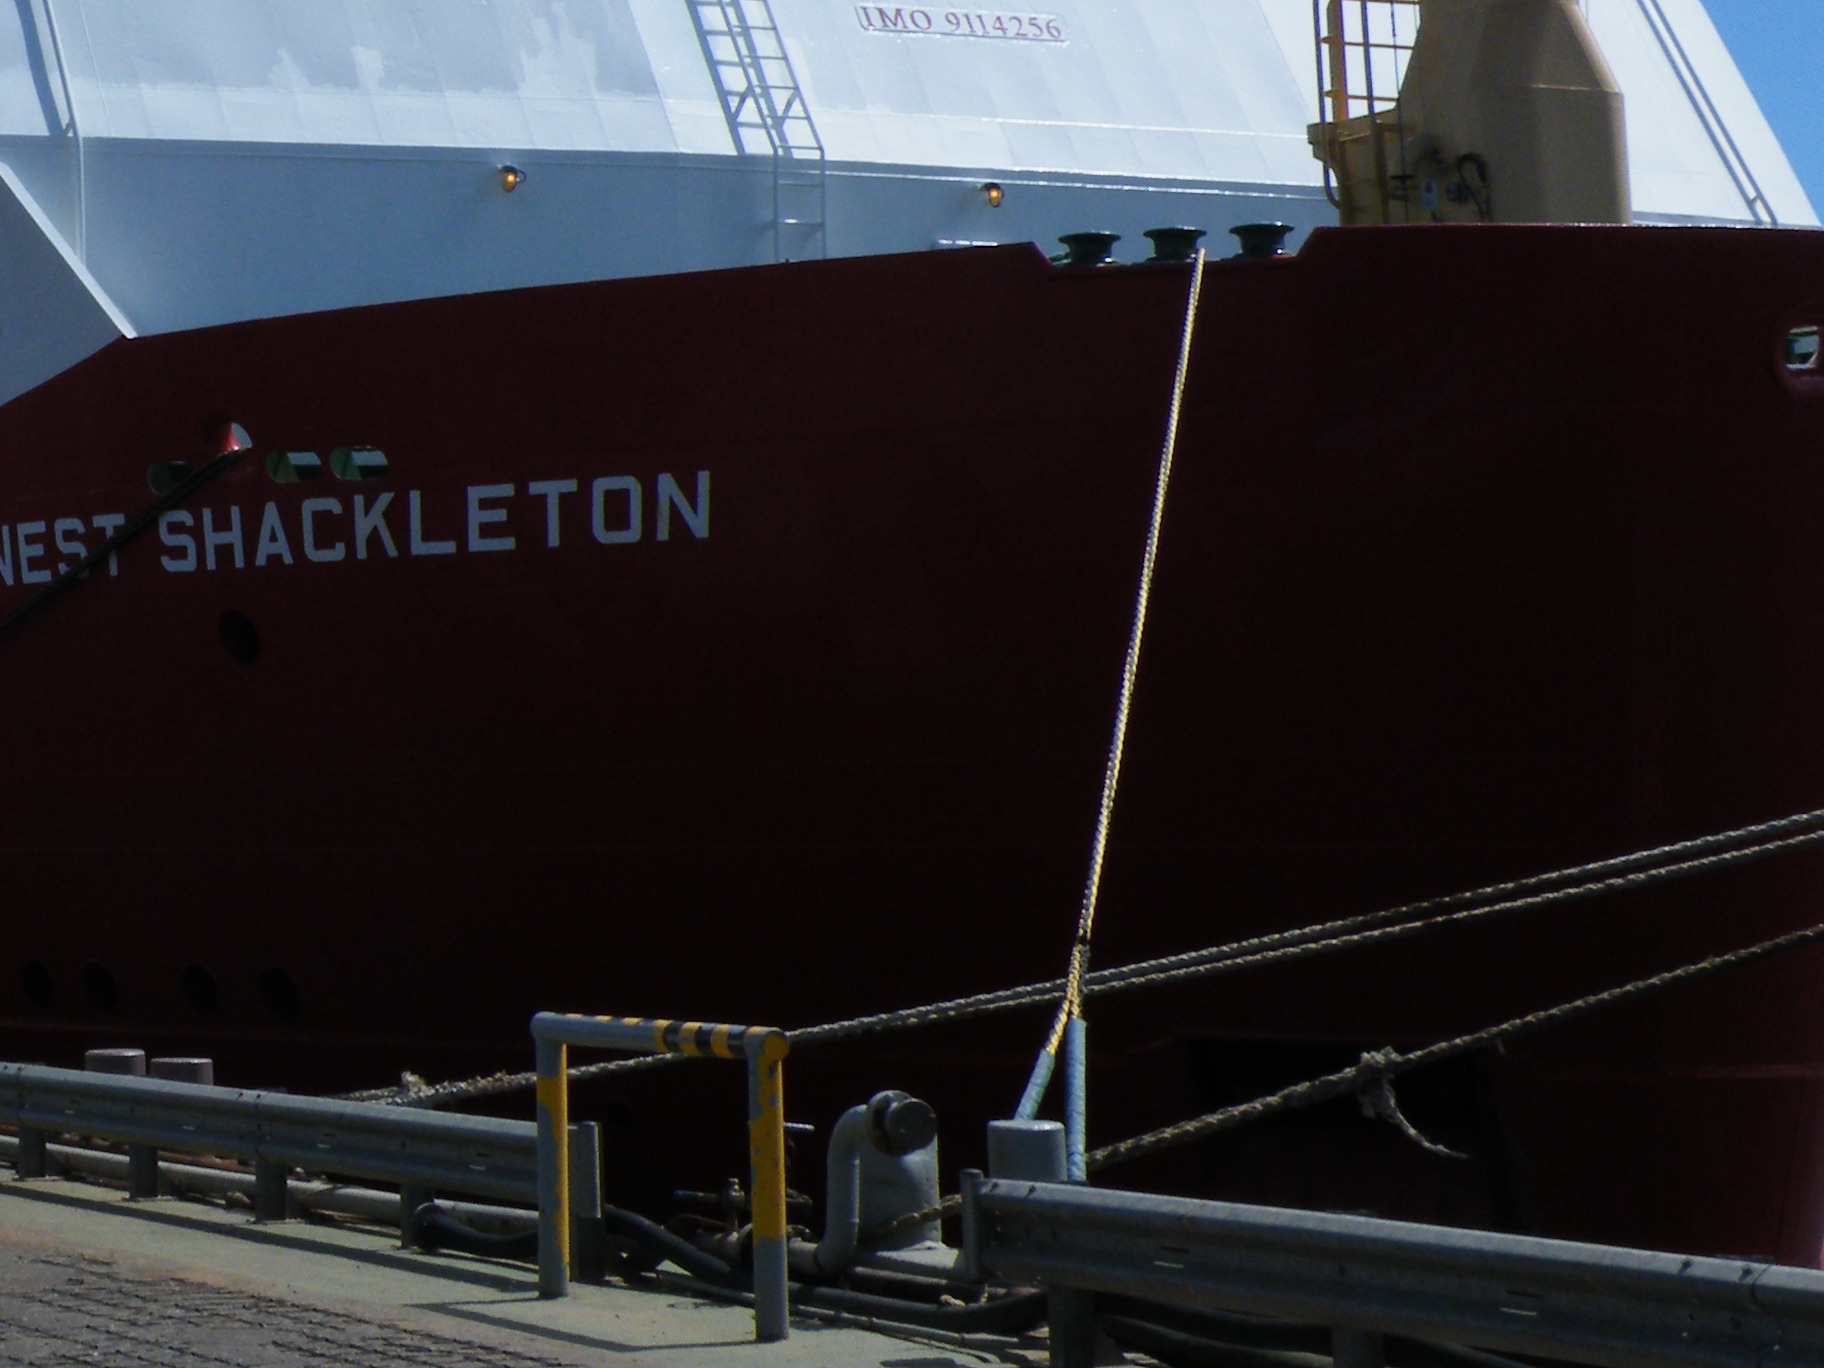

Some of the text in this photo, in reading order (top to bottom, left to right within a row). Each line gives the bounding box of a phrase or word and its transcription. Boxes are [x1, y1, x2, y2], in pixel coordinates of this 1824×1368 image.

[859, 6, 1062, 40] IMO 9114256
[158, 470, 711, 573] SHACKLETON
